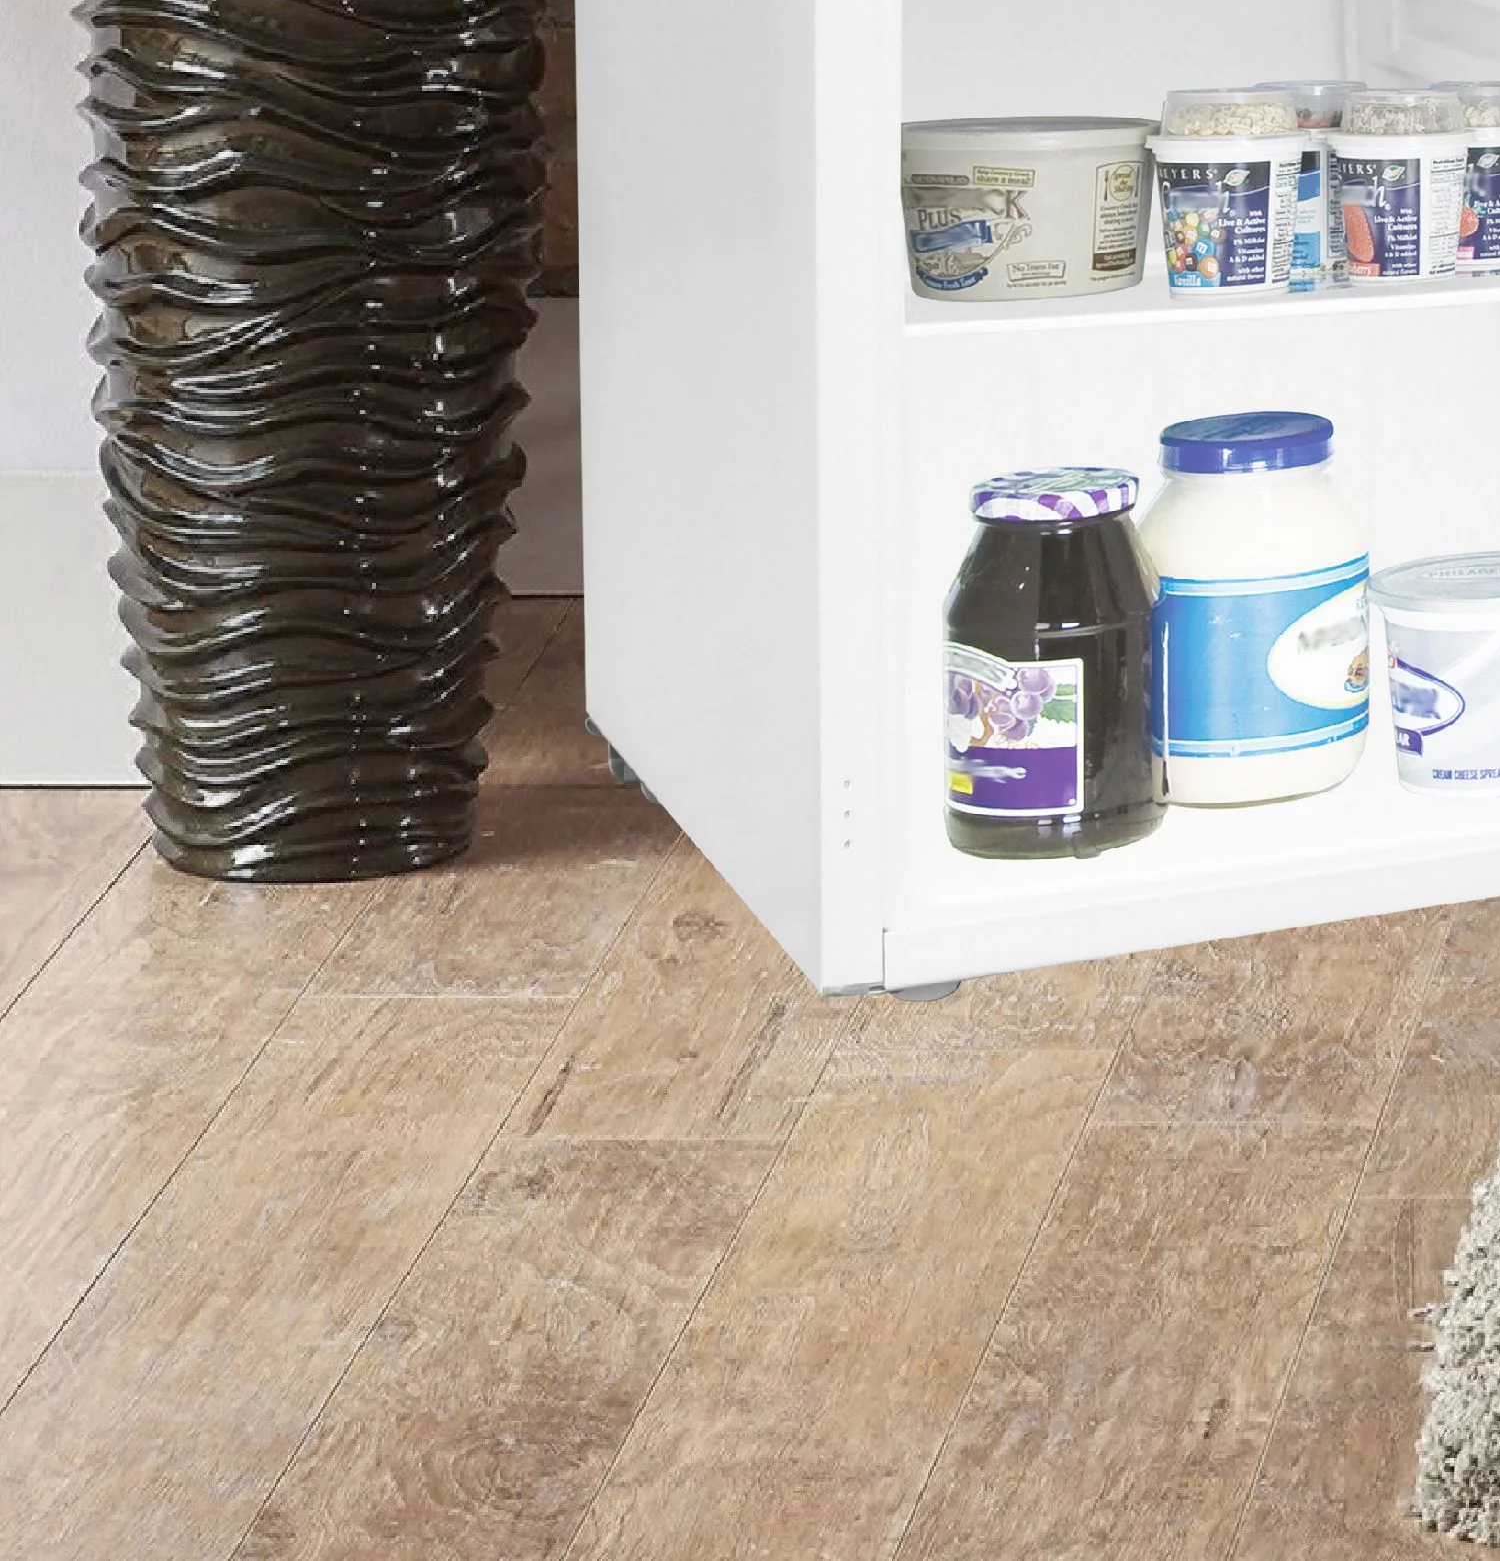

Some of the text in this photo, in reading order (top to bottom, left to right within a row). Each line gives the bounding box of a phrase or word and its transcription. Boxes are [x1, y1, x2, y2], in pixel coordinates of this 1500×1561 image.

[917, 208, 962, 232] PLUS
[1432, 768, 1453, 780] CREAM
[1454, 768, 1479, 780] CHEESE
